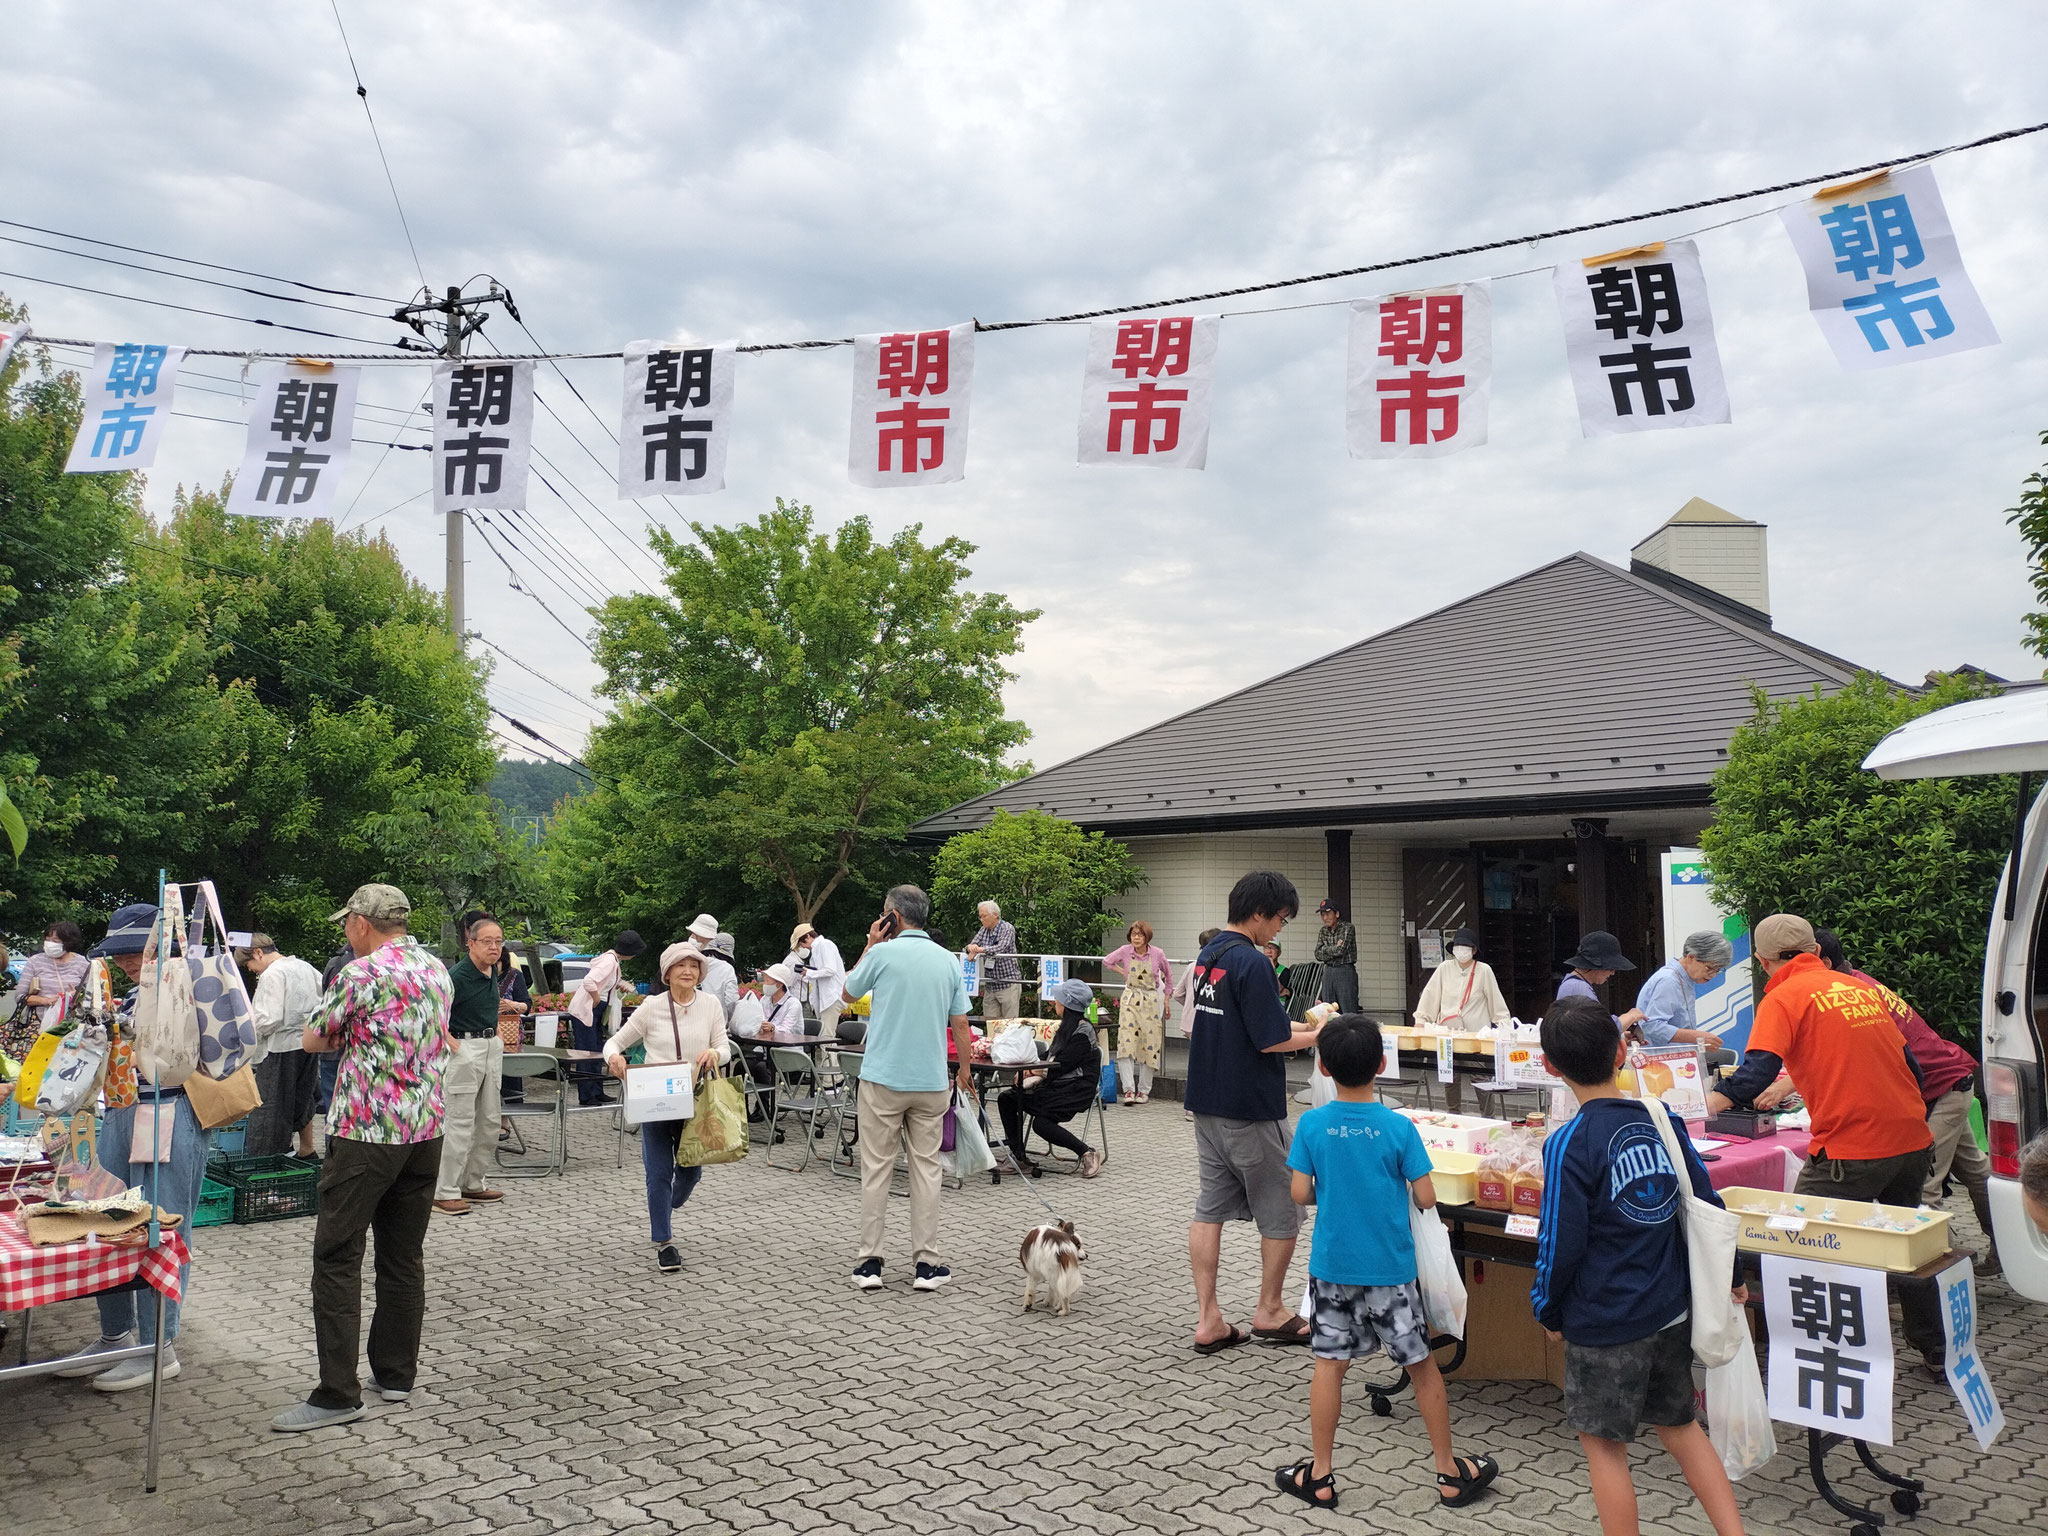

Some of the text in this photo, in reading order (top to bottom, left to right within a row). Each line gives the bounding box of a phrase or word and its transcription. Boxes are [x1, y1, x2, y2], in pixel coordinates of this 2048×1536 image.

[1585, 262, 1696, 416] 朝市
[1818, 193, 1956, 353] 朝市
[90, 342, 169, 459] 朝市
[444, 364, 514, 496] 朝市
[642, 347, 713, 483] 朝市
[875, 330, 951, 473] 朝市
[1106, 316, 1194, 455] 朝市
[1376, 294, 1466, 445] 朝市
[255, 378, 339, 505] 朝市
[963, 957, 976, 993] 朝市
[1045, 960, 1060, 997] 朝市
[1840, 1002, 1884, 1021] FARM
[1611, 1143, 1676, 1202] ADIDA
[1785, 1230, 1842, 1250] Vanille
[1788, 1274, 1871, 1420] 朝市
[1947, 1278, 1993, 1428] 朝市
